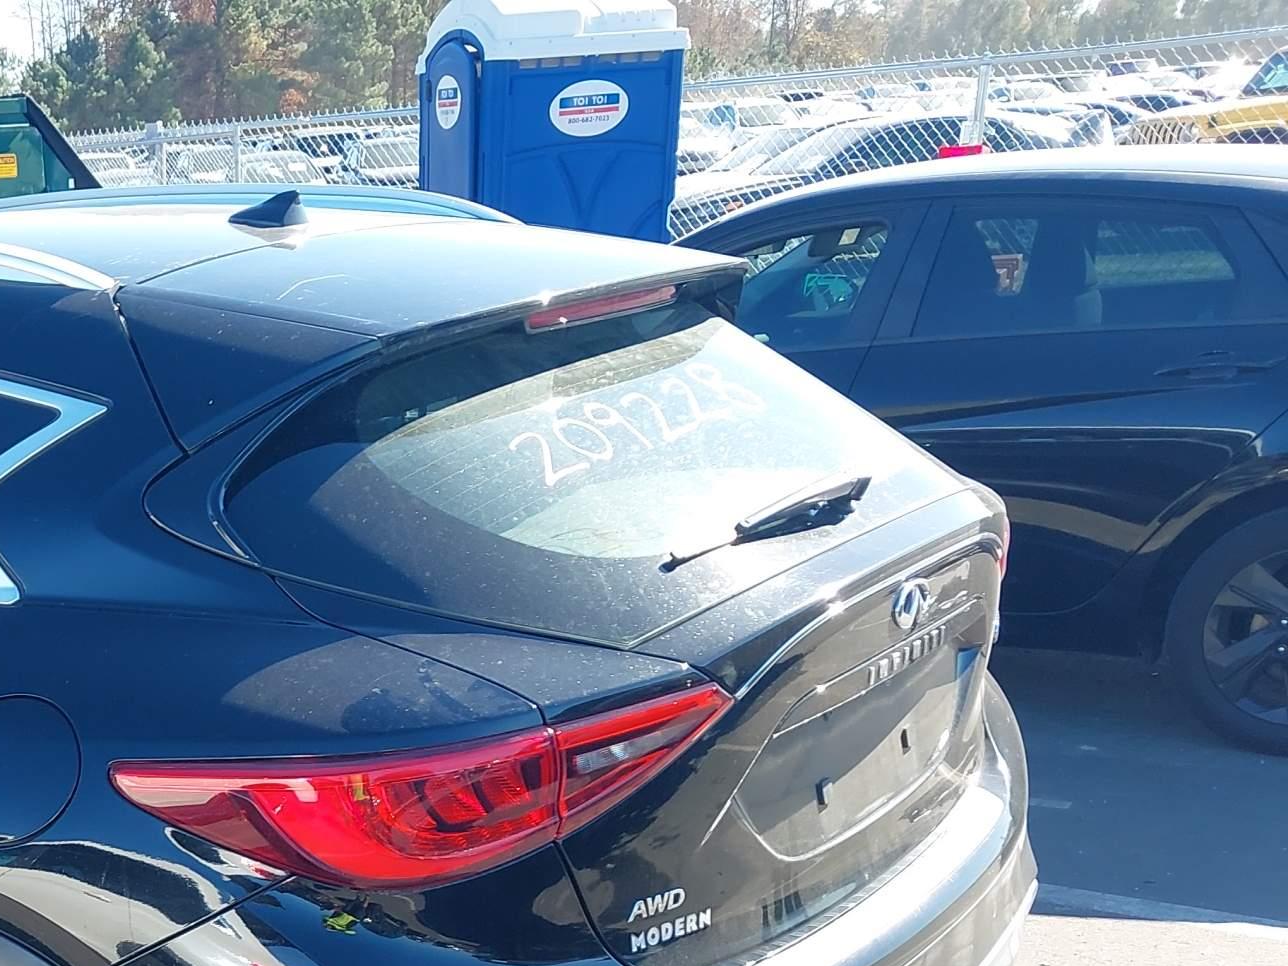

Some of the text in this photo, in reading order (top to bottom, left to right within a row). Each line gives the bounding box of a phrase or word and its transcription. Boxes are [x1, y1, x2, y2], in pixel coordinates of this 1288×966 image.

[573, 95, 608, 106] TOI TOI
[627, 888, 685, 923] AWD
[630, 907, 712, 953] MODERN
